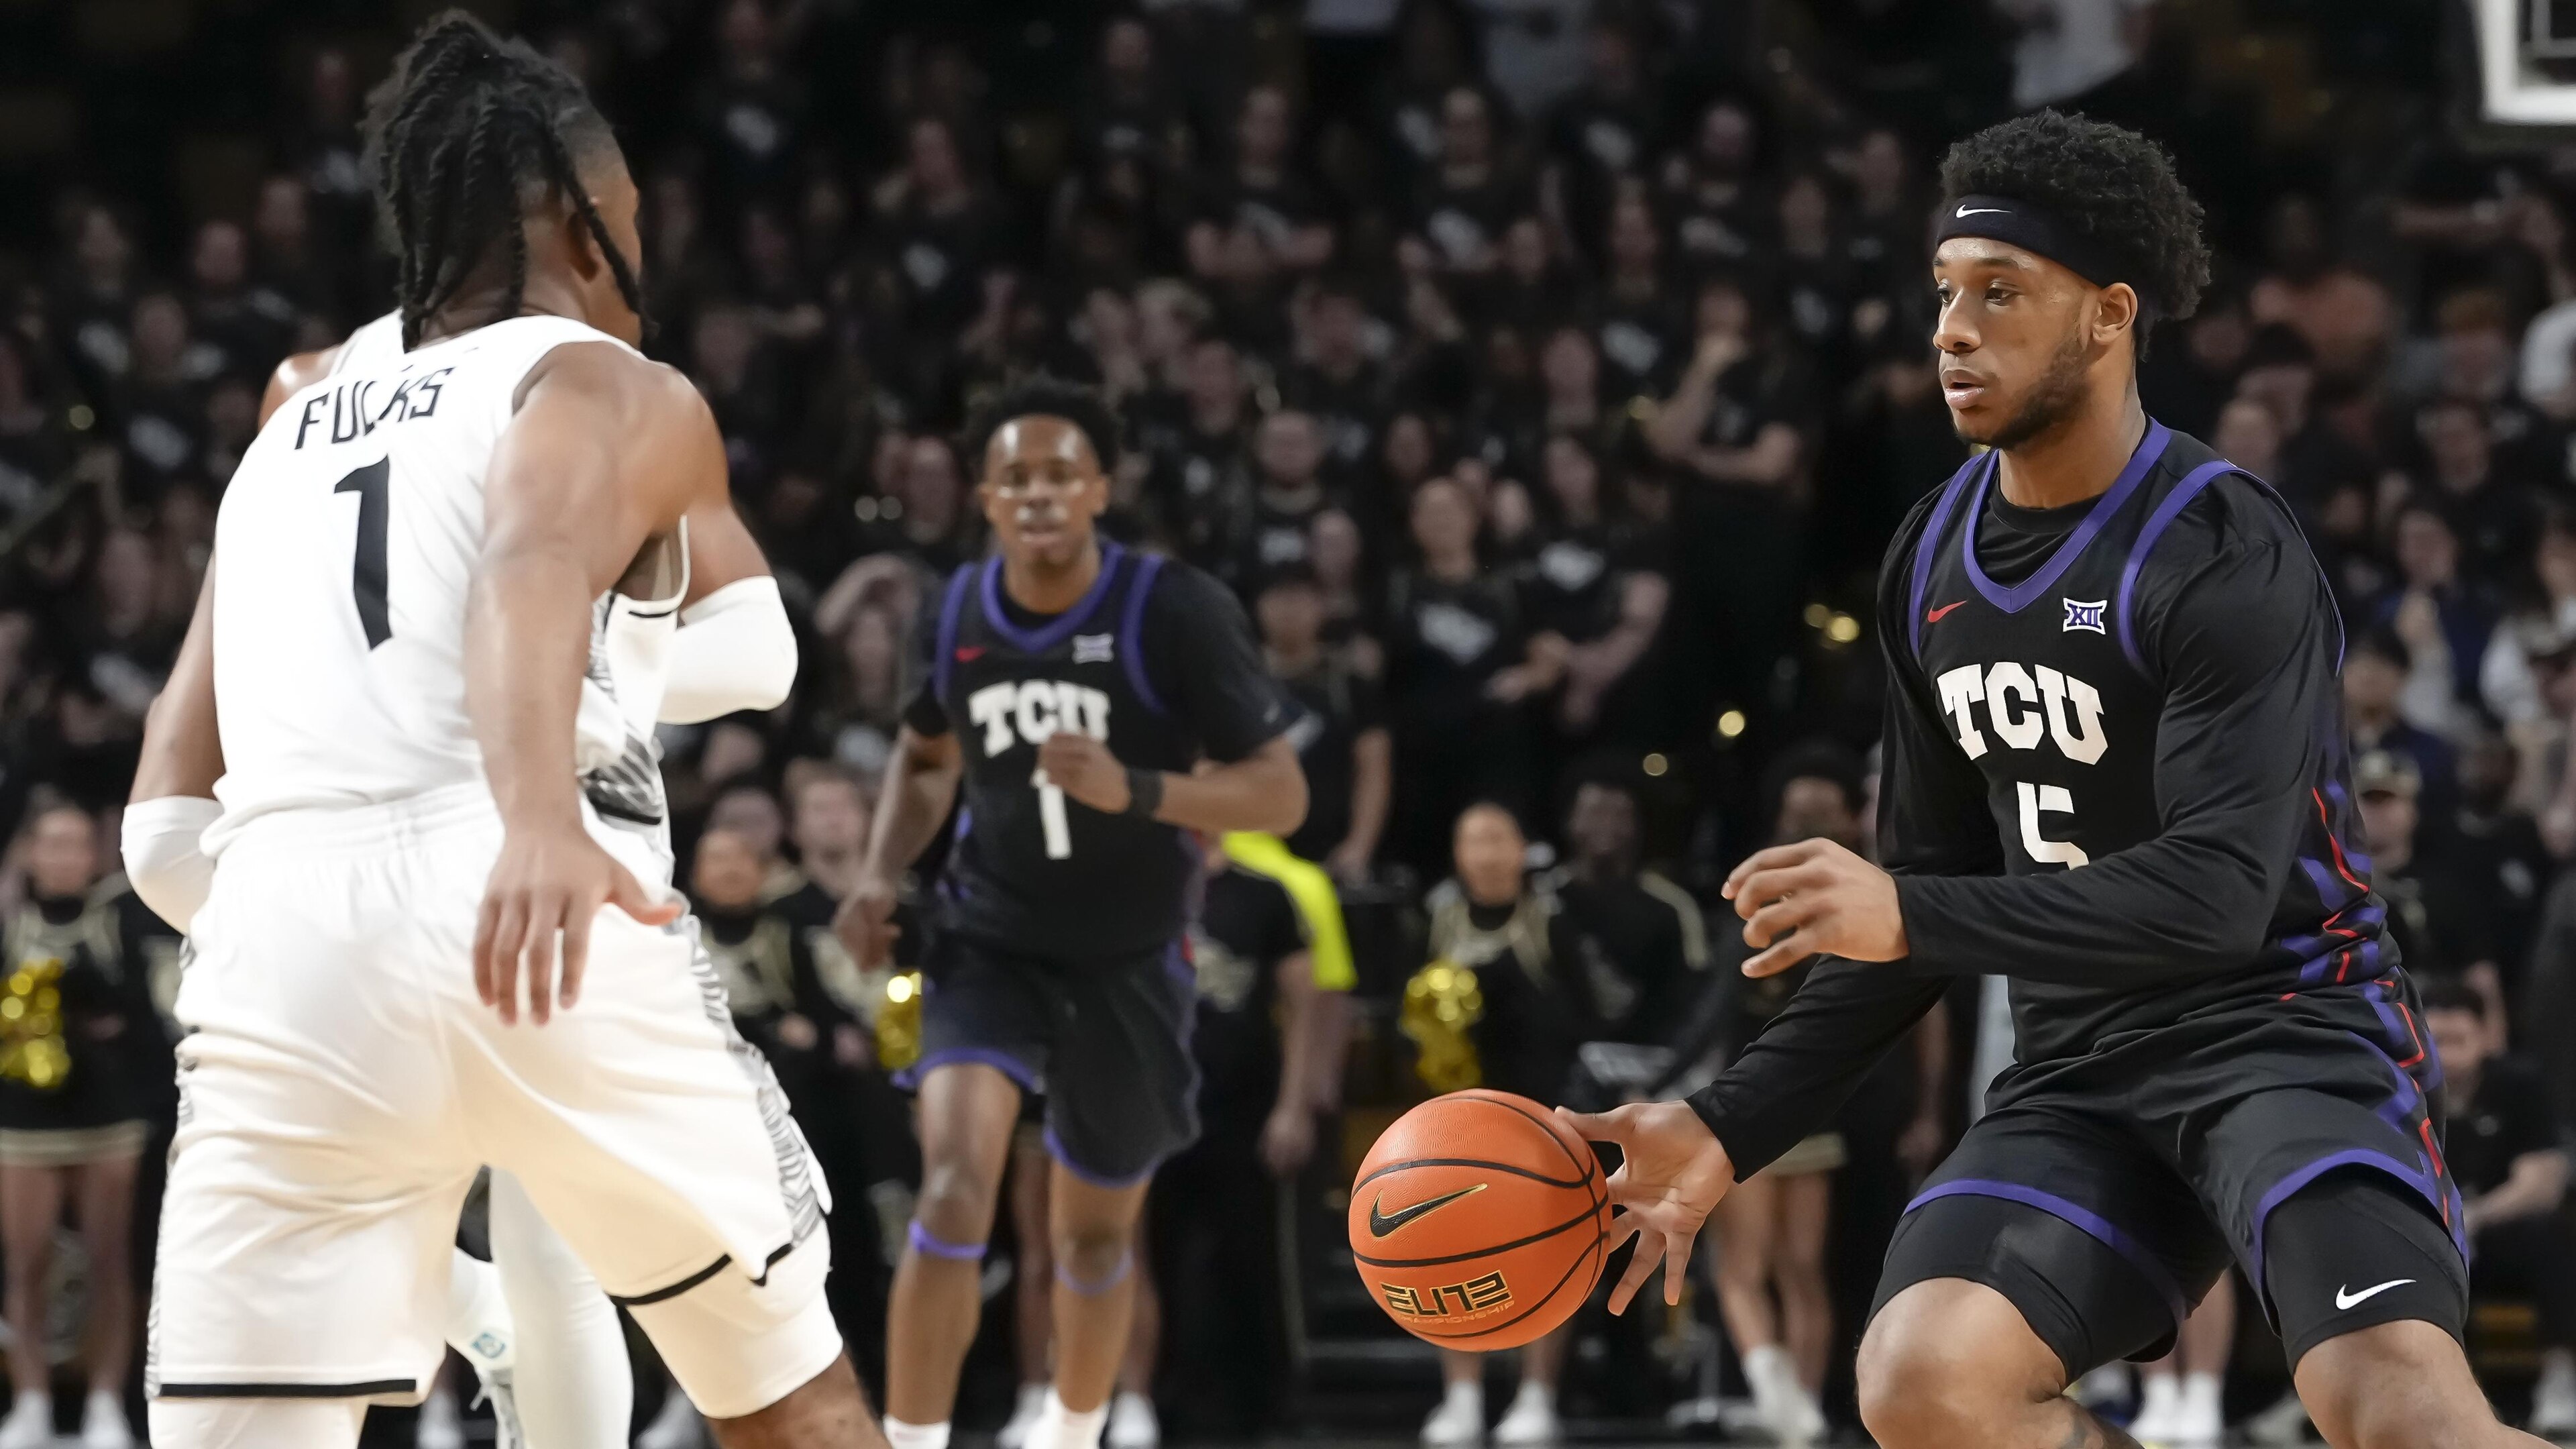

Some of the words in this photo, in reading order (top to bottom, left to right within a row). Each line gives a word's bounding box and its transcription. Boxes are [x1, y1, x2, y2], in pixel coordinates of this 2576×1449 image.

[334, 453, 393, 651] 1
[2066, 602, 2104, 631] XII
[967, 678, 1112, 759] TCU
[1937, 661, 2108, 765] TCU
[1030, 767, 1073, 861] 1
[2017, 781, 2090, 871] 5
[1380, 1269, 1513, 1318] ELITE
